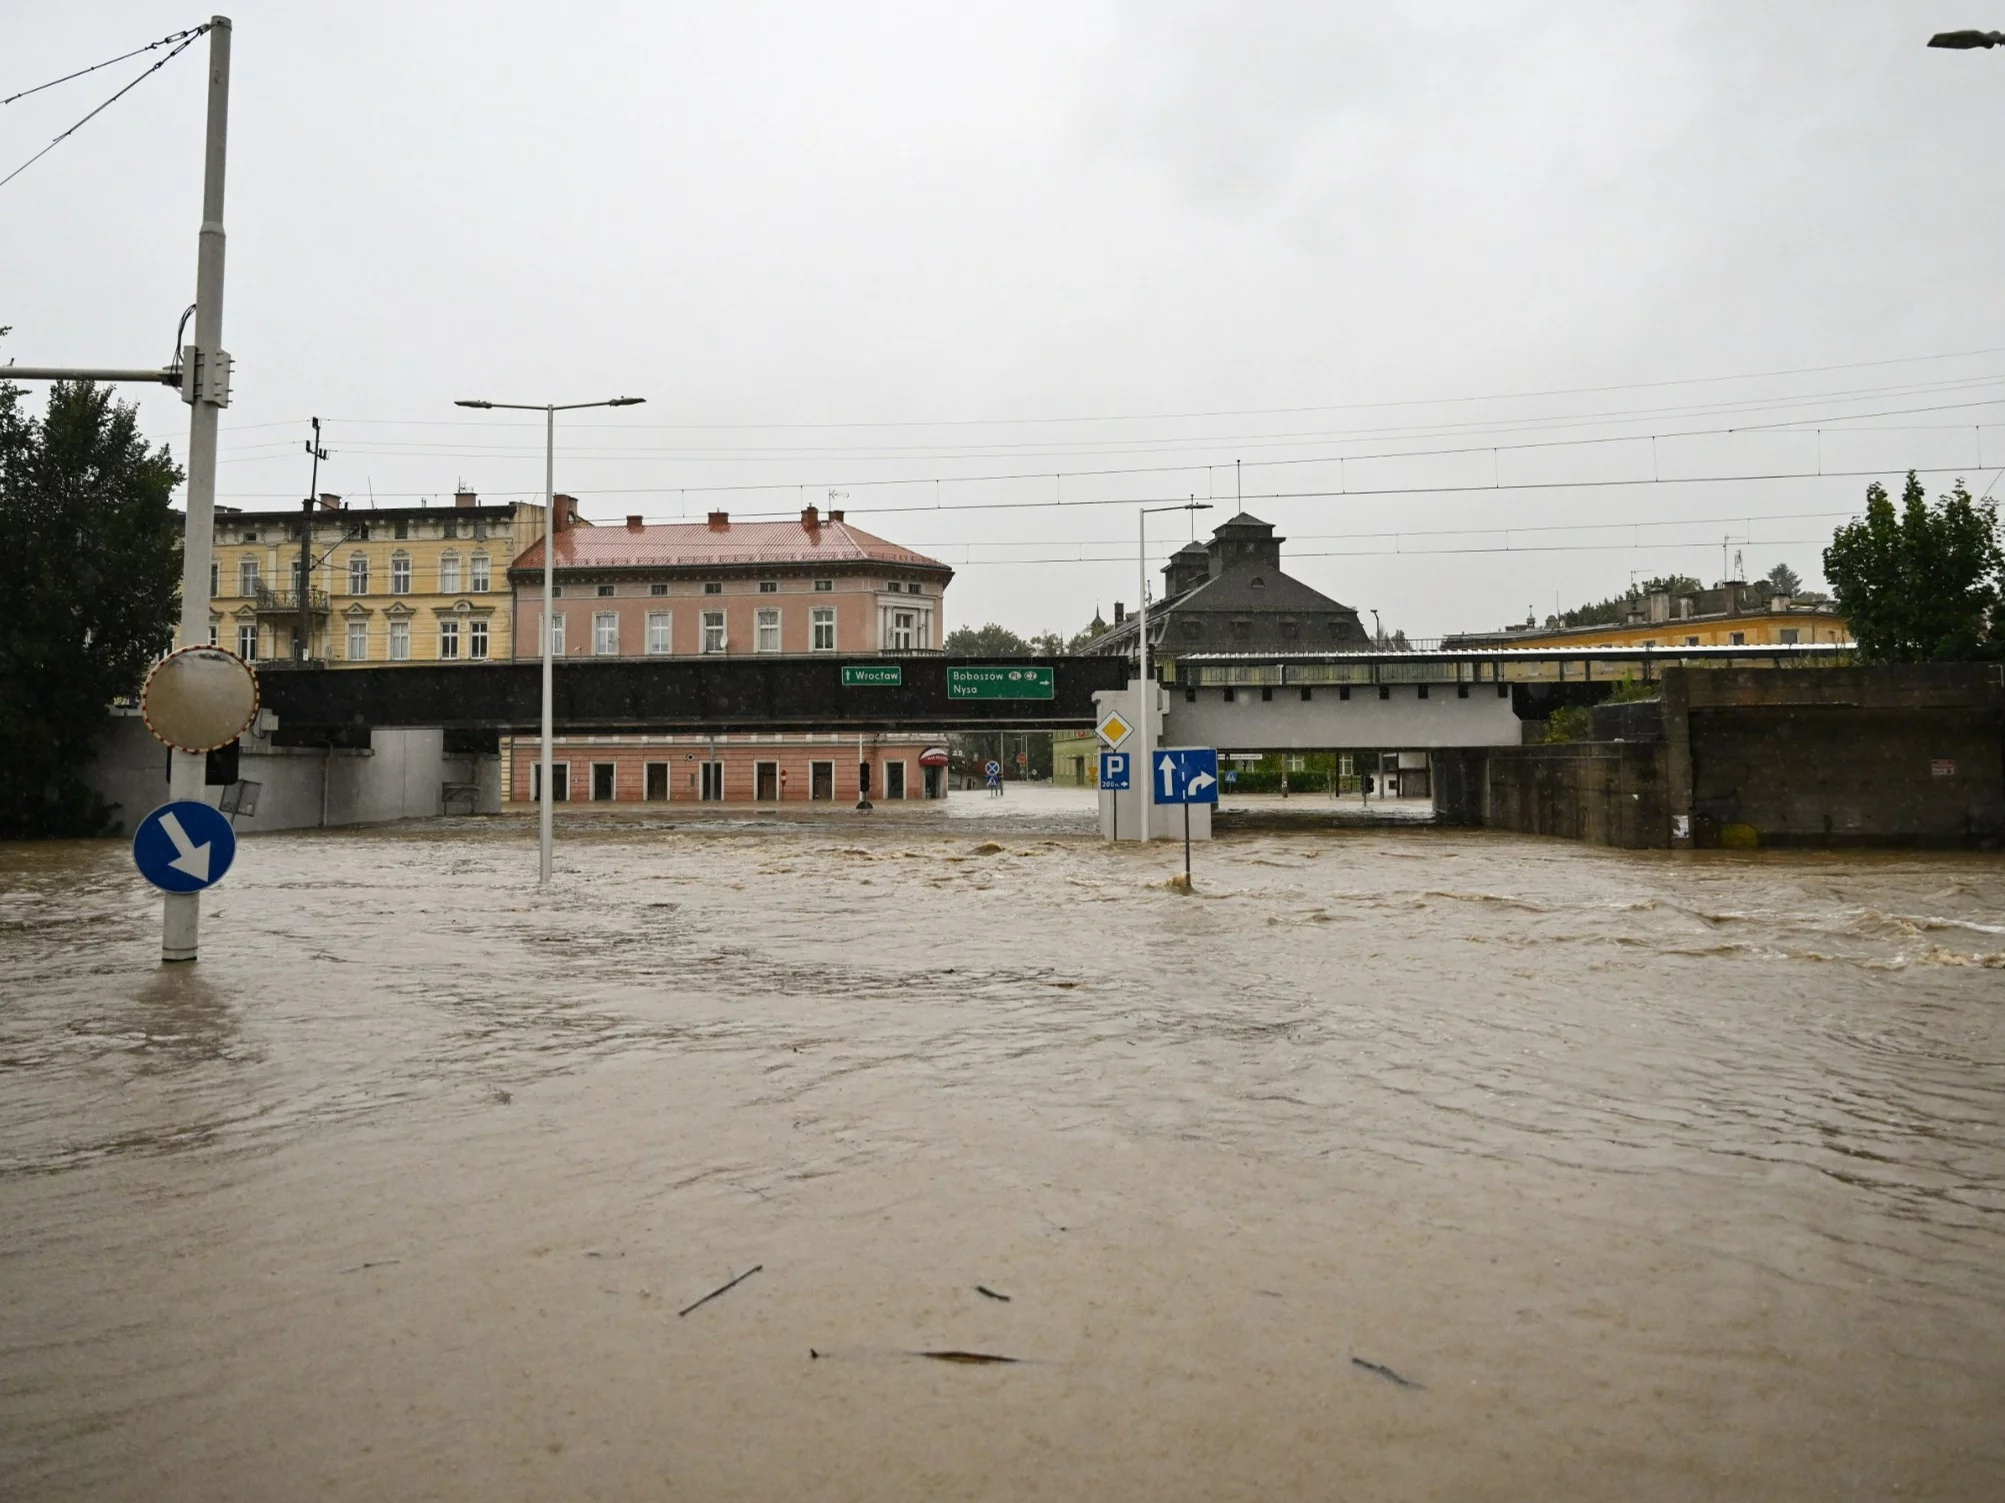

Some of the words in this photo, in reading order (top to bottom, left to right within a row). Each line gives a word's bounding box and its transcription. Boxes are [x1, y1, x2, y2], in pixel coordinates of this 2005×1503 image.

[855, 670, 898, 681] Wrocław
[953, 671, 1004, 681] Boboszów
[953, 684, 978, 696] Nysa
[1107, 756, 1124, 779] P
